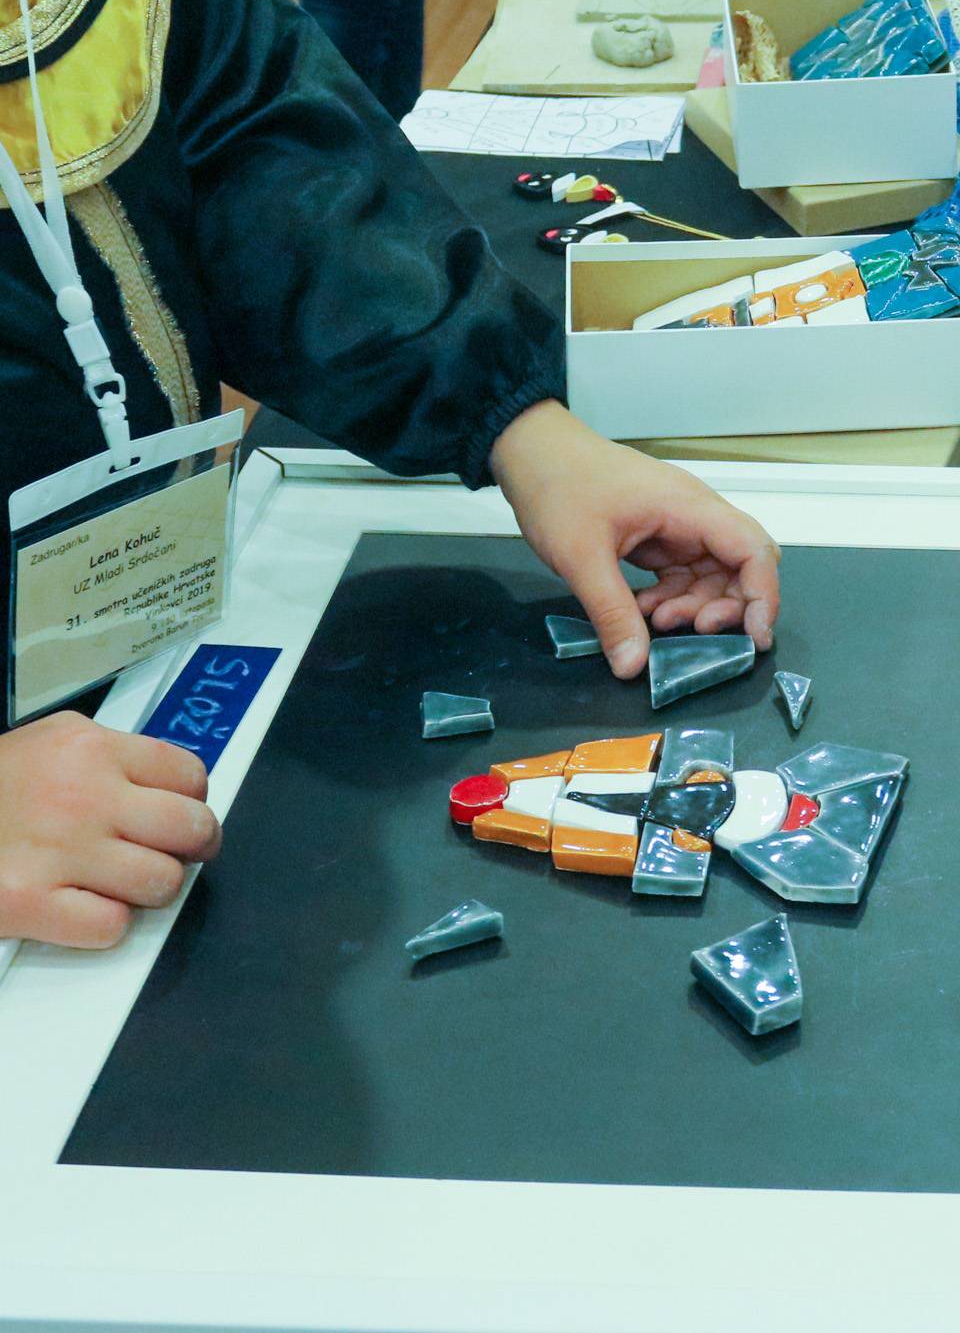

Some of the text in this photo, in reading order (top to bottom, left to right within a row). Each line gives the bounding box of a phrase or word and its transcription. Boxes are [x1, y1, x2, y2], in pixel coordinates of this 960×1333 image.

[74, 540, 176, 594] UZ Mladi Srdočani
[90, 526, 161, 568] Lena Kohuč
[66, 556, 216, 631] 31. smotra učeničkih zadruga
[124, 591, 169, 616] Republike
[173, 569, 215, 593] Hrvatske
[145, 596, 183, 620] Vinkovci
